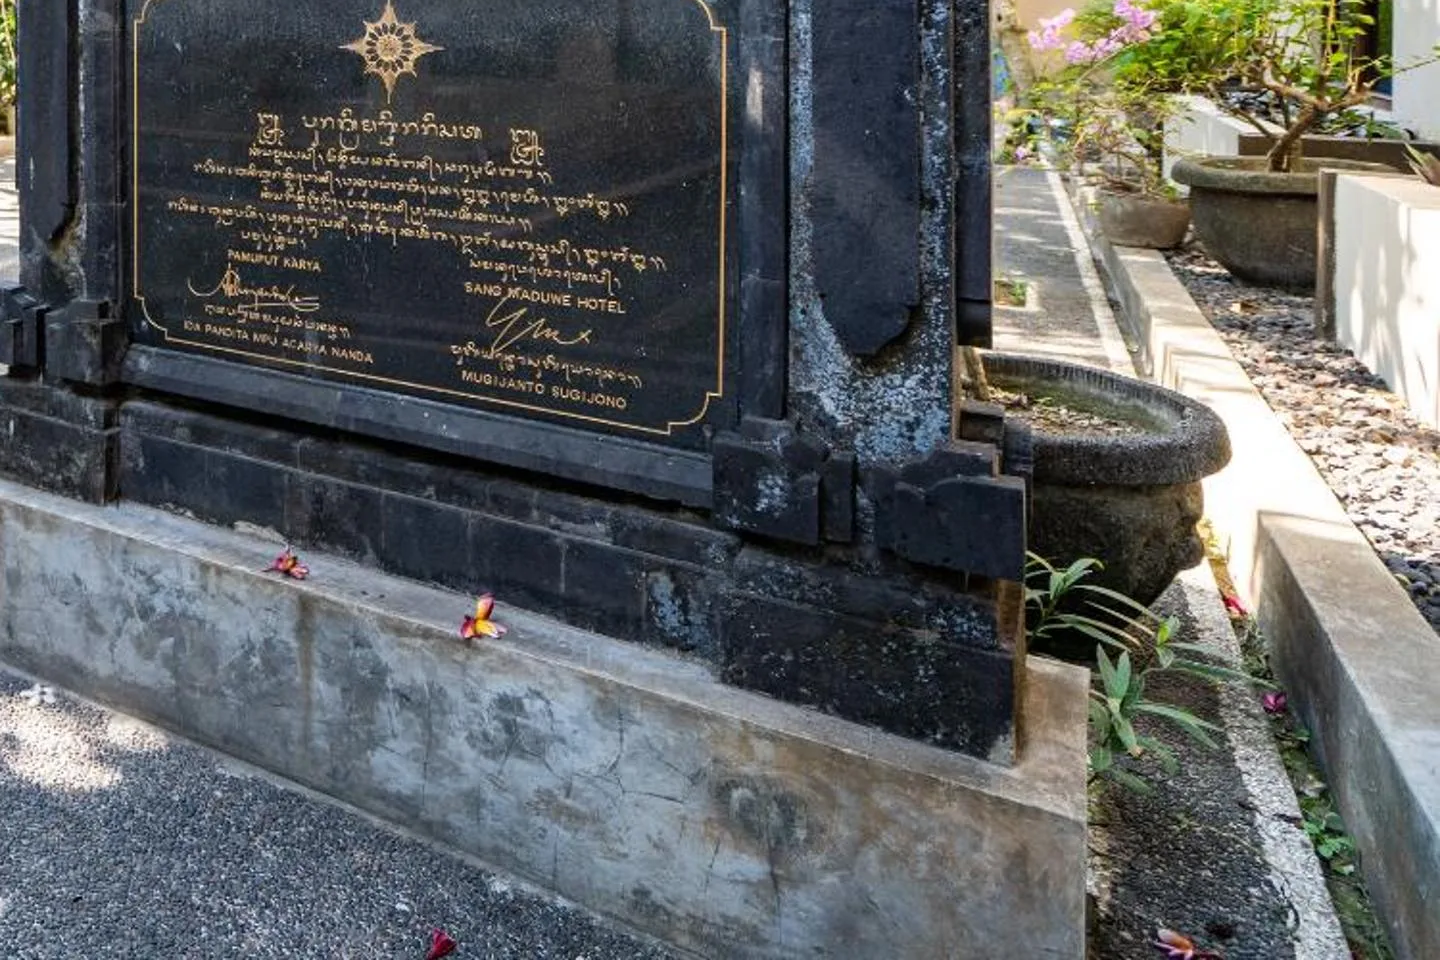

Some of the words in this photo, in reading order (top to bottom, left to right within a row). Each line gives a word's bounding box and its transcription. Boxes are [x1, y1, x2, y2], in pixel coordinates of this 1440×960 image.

[227, 248, 279, 267] PAMUPUT
[283, 257, 322, 273] KARYA
[507, 286, 572, 307] MADUWE
[576, 297, 627, 314] HOTEL
[204, 324, 250, 341] PANDITA
[252, 332, 278, 346] MPU
[281, 339, 327, 356] ACARYA
[331, 346, 374, 364] NANDA
[461, 369, 545, 395] MUGIJANTO
[551, 385, 628, 409] SUGIJONO
